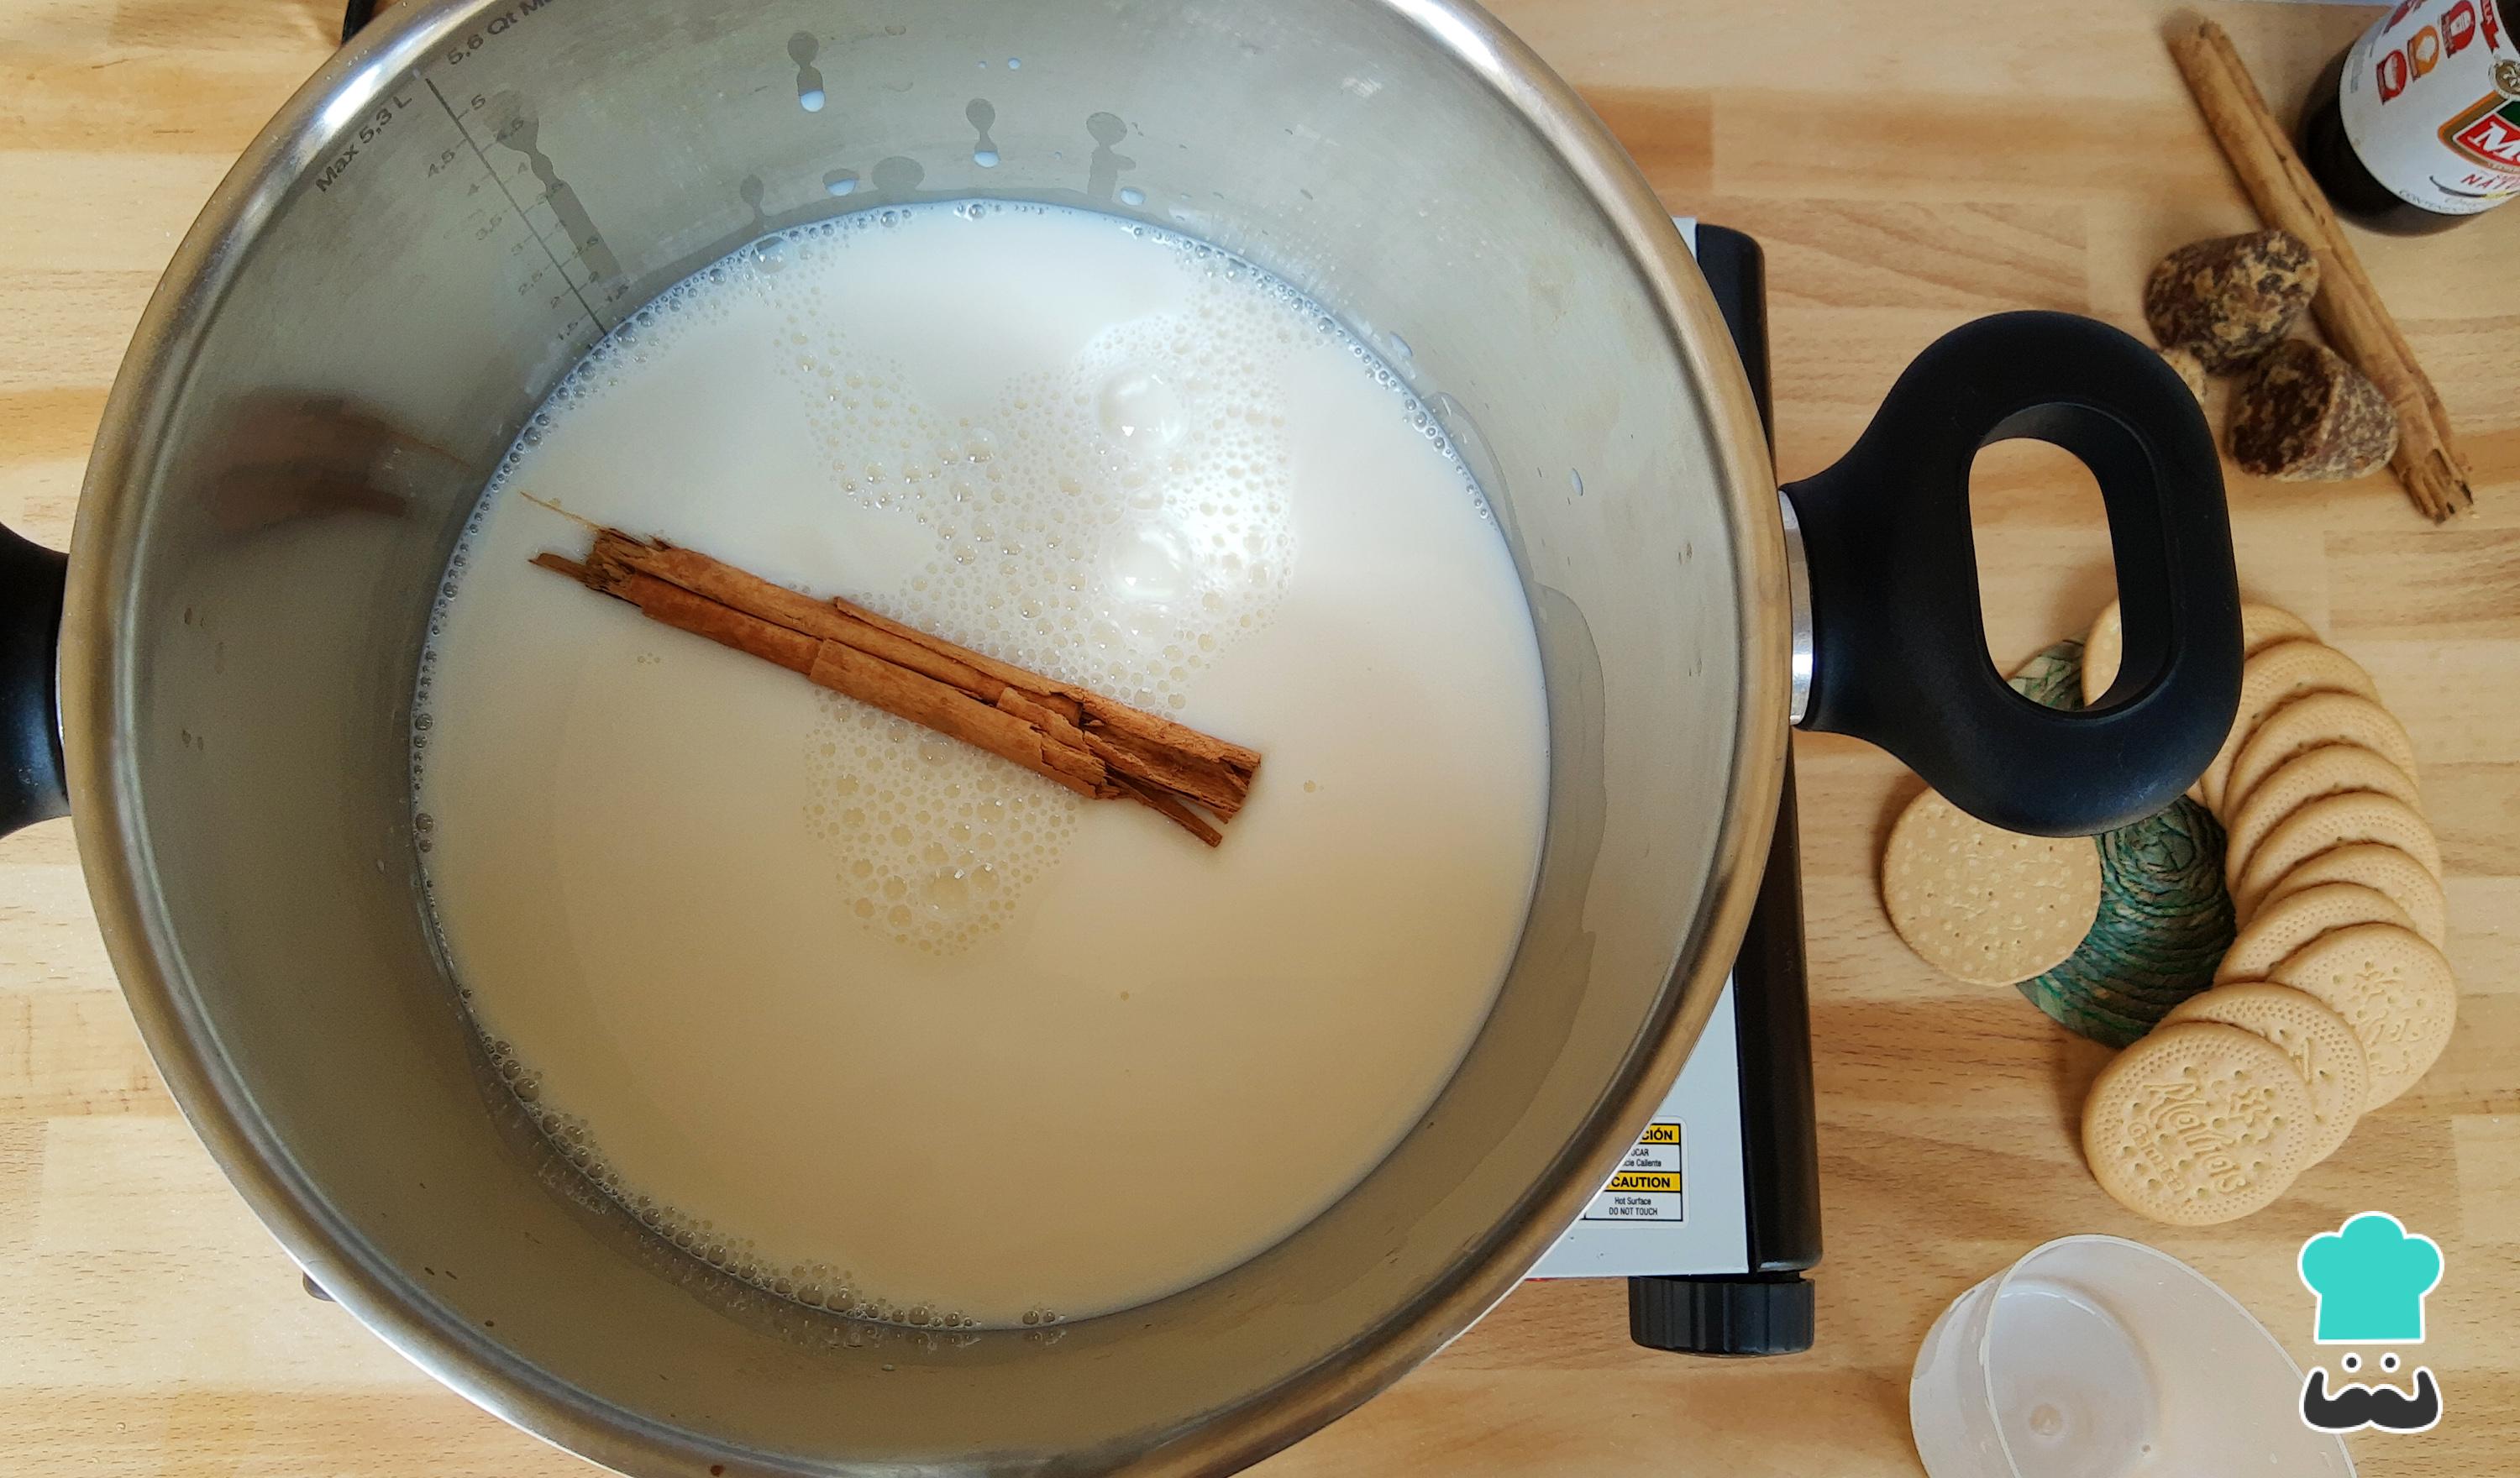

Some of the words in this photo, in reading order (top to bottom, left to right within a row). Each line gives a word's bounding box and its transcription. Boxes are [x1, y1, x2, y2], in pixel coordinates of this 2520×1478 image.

[448, 34, 484, 65] 5.6
[487, 13, 518, 34] Qt
[470, 94, 486, 111] 5
[315, 144, 360, 192] Max
[359, 108, 392, 144] 5.3
[392, 96, 412, 108] L
[427, 149, 456, 178] 4.5
[1611, 1177, 1670, 1188] CAUTION
[1614, 1197, 1625, 1205] Hot
[1627, 1197, 1651, 1205] Surface
[1609, 1207, 1619, 1215] DO
[1620, 1207, 1634, 1215] NOT
[1635, 1208, 1658, 1216] TOUCH
